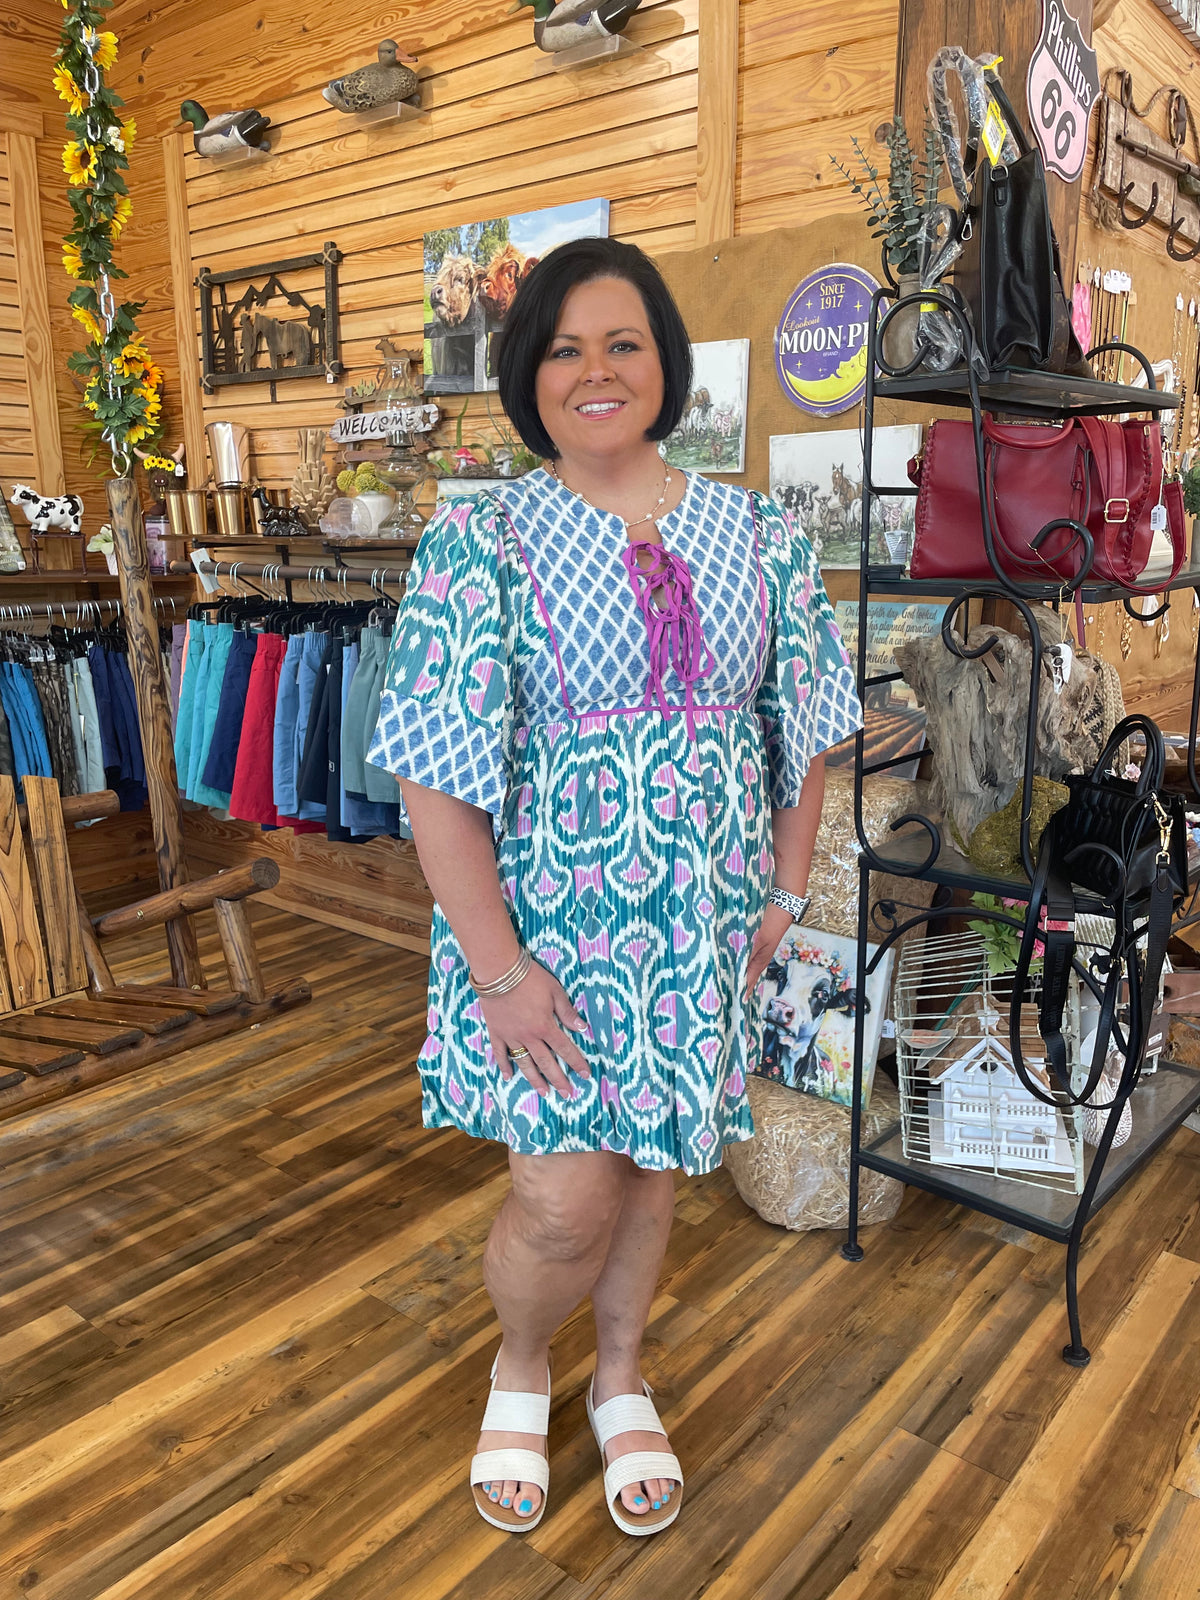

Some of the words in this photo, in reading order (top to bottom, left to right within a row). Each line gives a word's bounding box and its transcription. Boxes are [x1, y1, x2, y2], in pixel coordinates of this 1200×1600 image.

[1047, 1, 1092, 107] Phillips
[1041, 79, 1077, 160] 66
[820, 283, 846, 297] SINCE
[820, 295, 844, 310] 1917
[785, 316, 821, 332] Lookout
[780, 325, 844, 355] MOON
[340, 411, 415, 436] WELCOME
[902, 608, 915, 619] God
